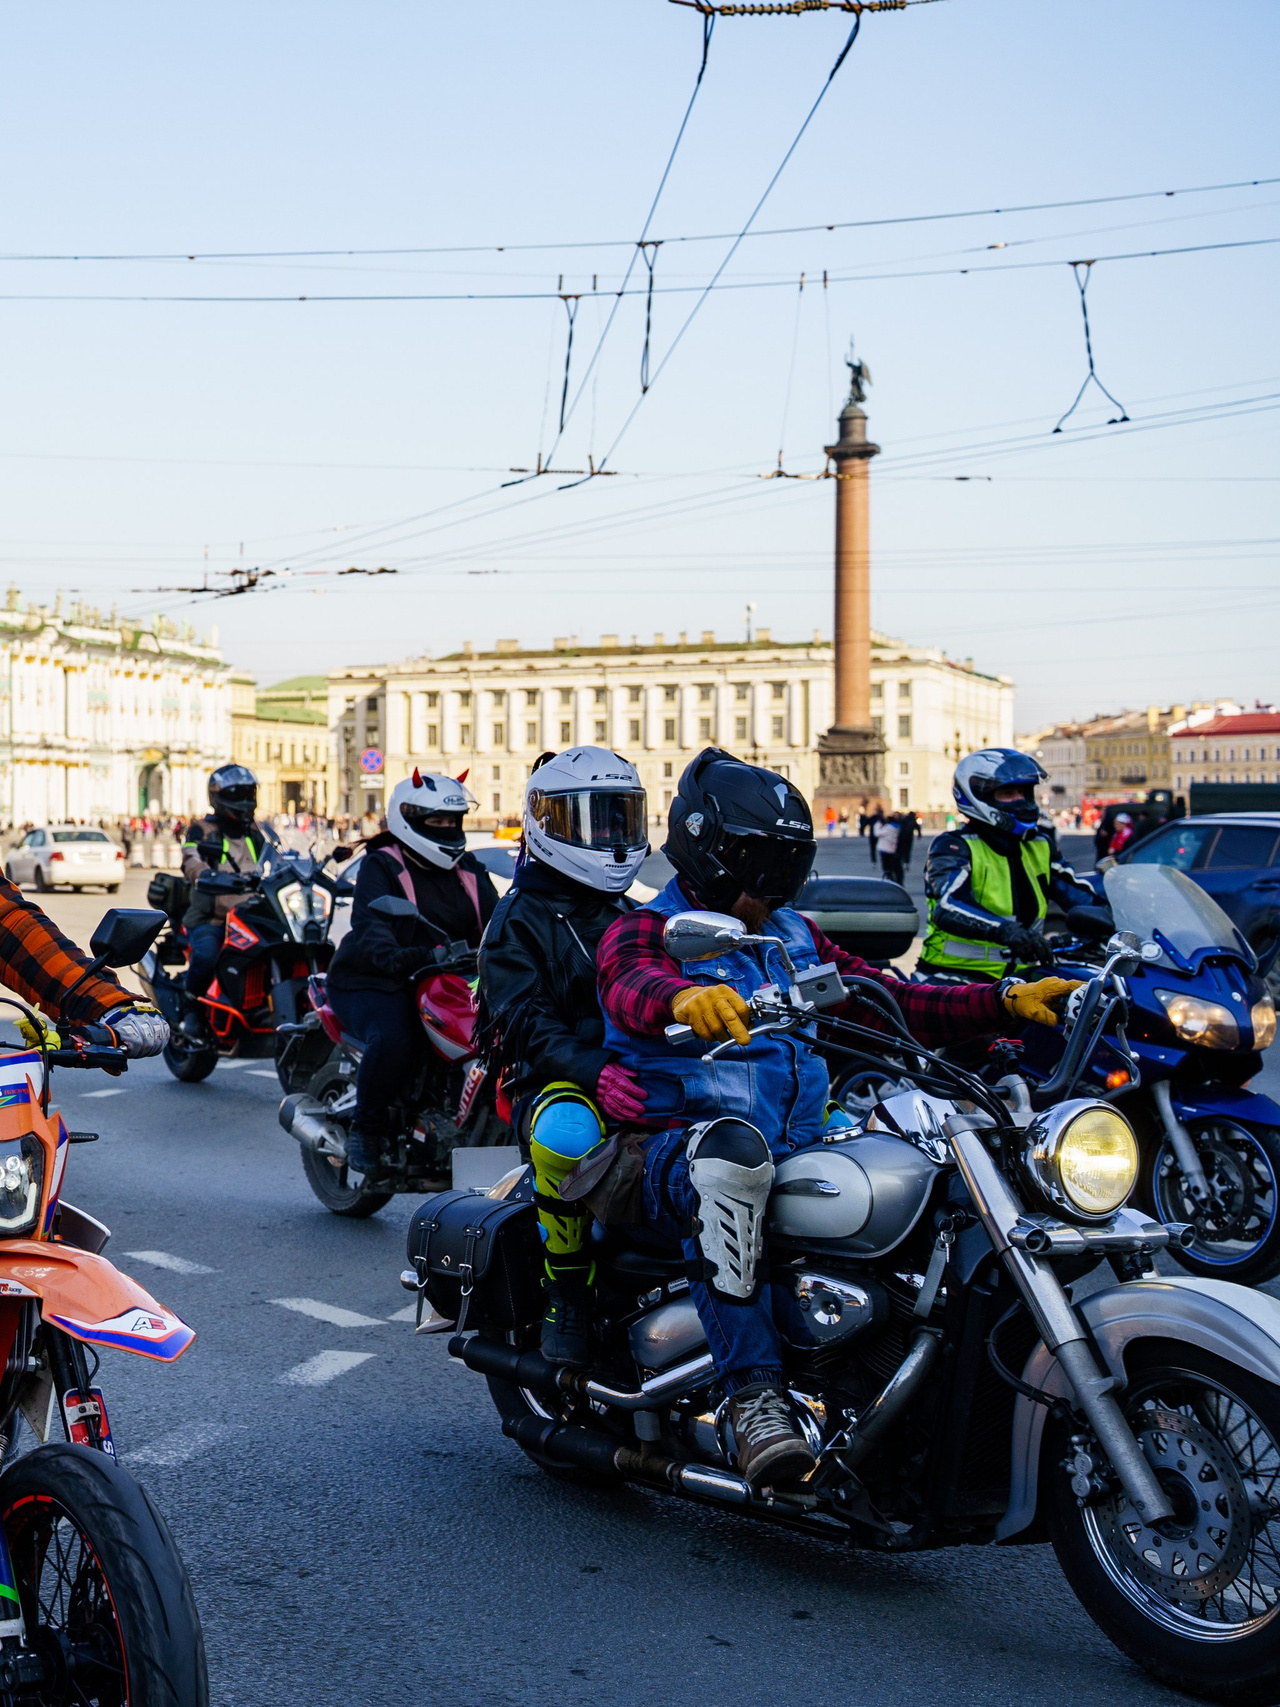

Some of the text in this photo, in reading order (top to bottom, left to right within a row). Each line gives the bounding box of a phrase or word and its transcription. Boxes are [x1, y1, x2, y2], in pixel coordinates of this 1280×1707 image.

[590, 774, 632, 782] LS2
[775, 818, 811, 832] LS2
[528, 831, 553, 858] LS2
[458, 1068, 480, 1120] NITRO
[131, 1317, 167, 1332] A5
